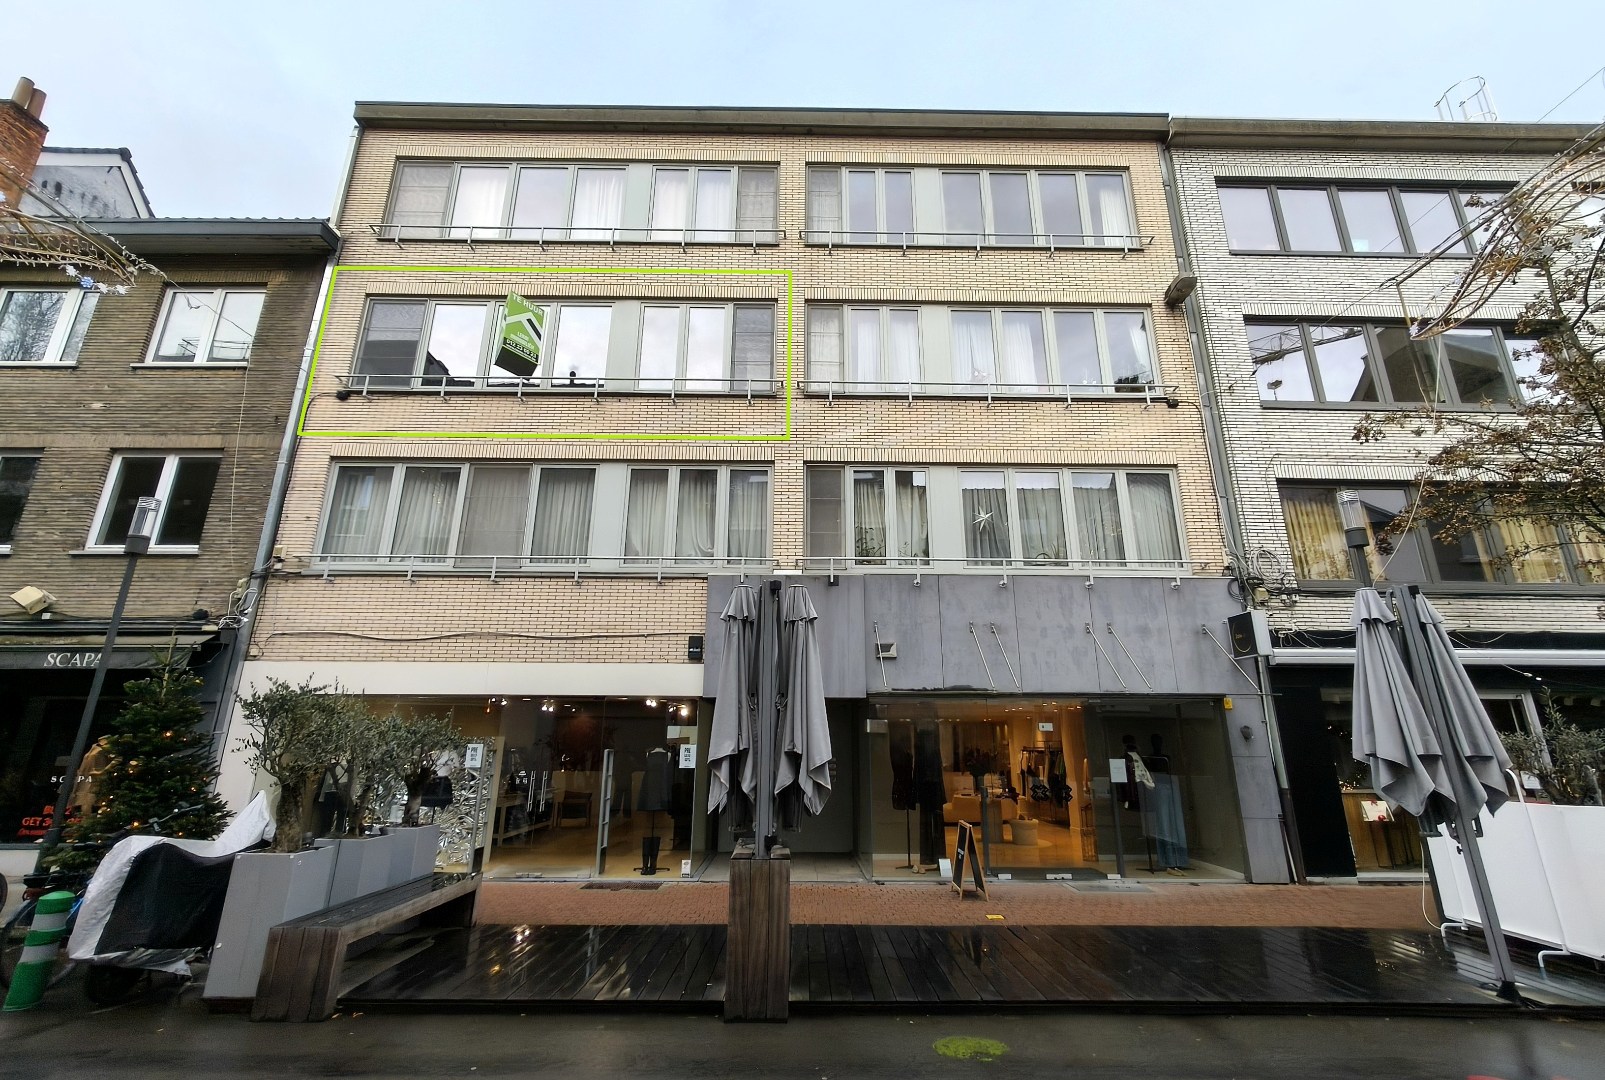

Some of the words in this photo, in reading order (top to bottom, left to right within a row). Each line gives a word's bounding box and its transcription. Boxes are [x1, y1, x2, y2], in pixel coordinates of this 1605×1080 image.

[512, 293, 522, 303] TE
[523, 301, 544, 316] HUUR
[51, 775, 92, 783] SCPA
[22, 817, 42, 826] GET
